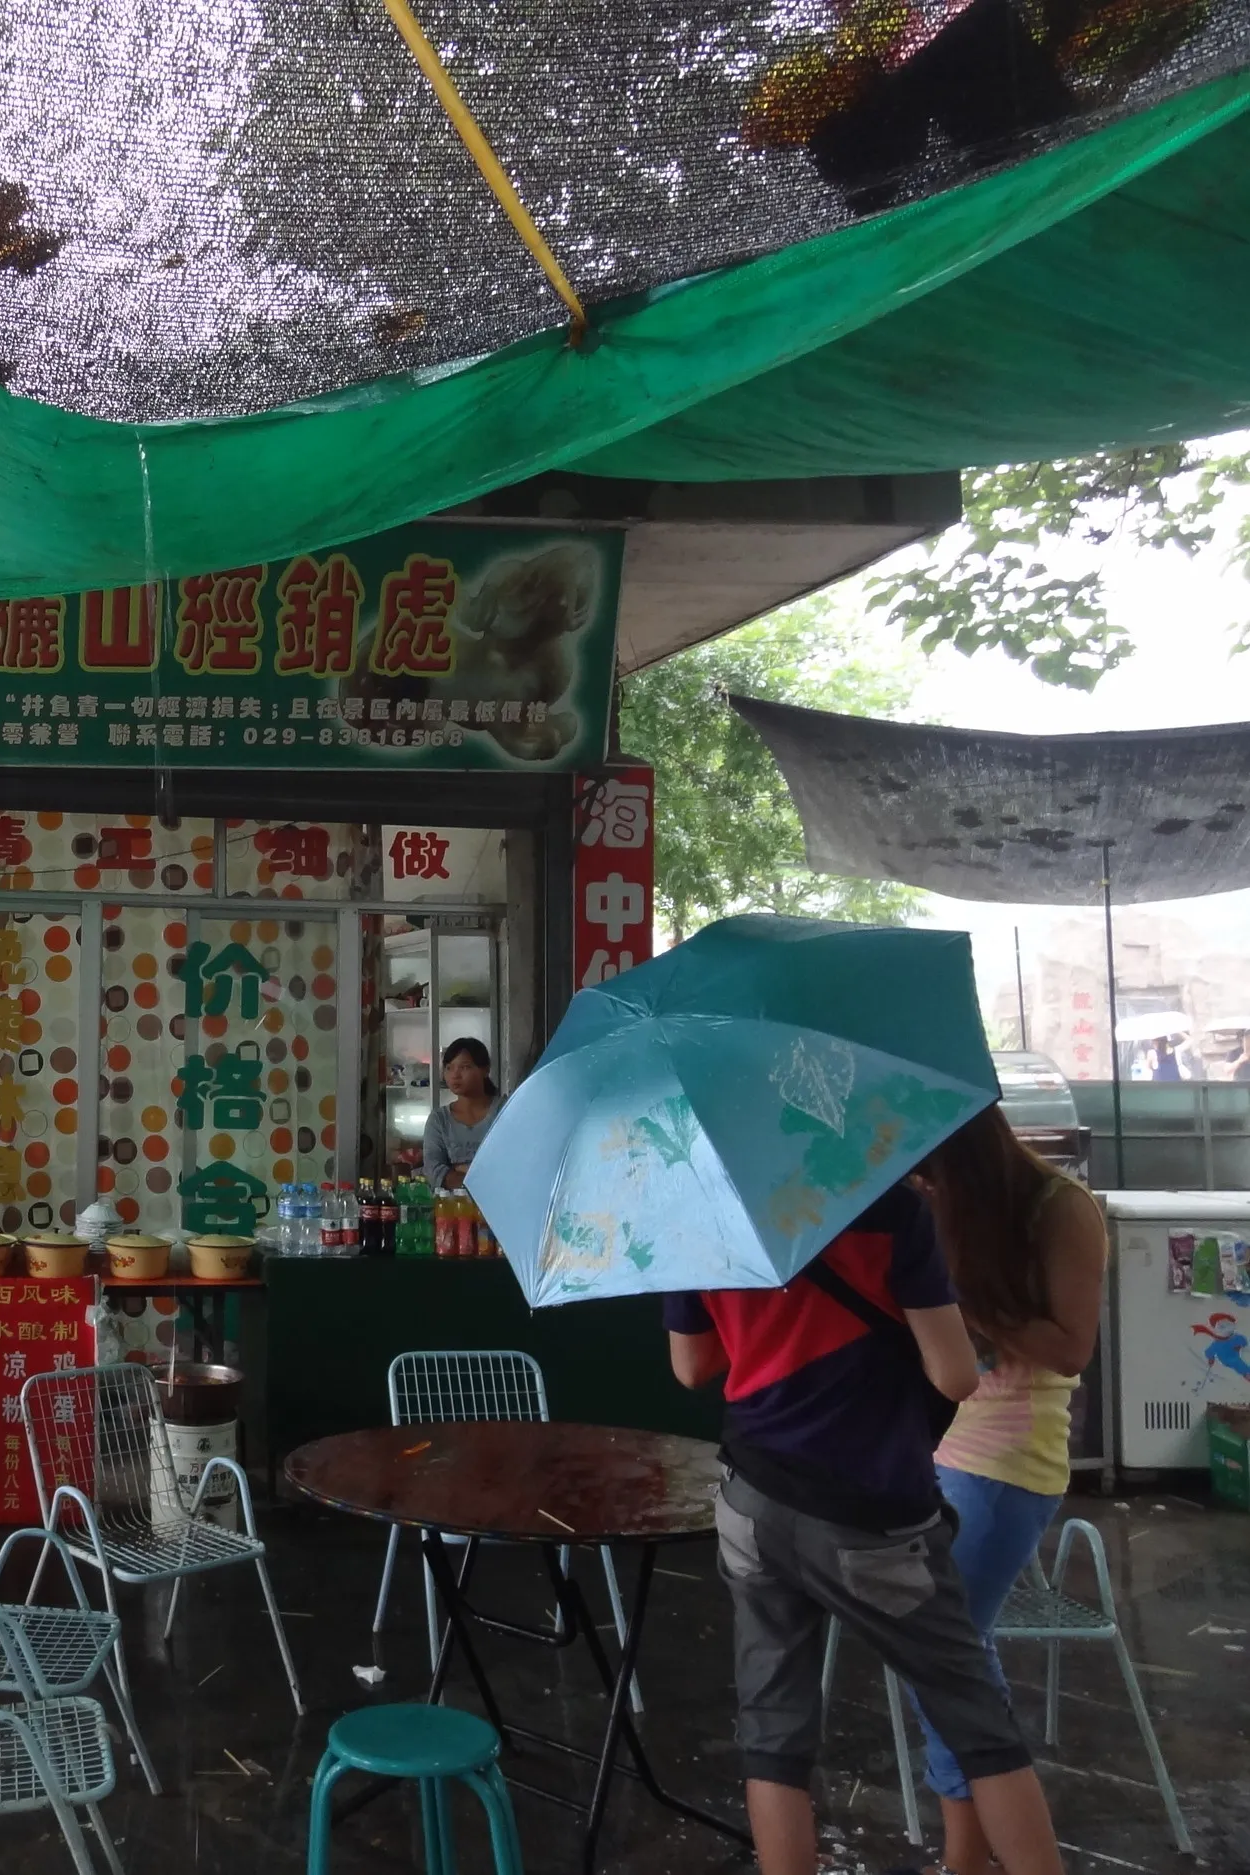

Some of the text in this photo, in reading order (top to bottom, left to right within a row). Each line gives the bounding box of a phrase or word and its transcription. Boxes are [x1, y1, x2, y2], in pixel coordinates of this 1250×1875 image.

[177, 940, 271, 1240] 价格合
[3, 1434, 21, 1511] 每份八元
